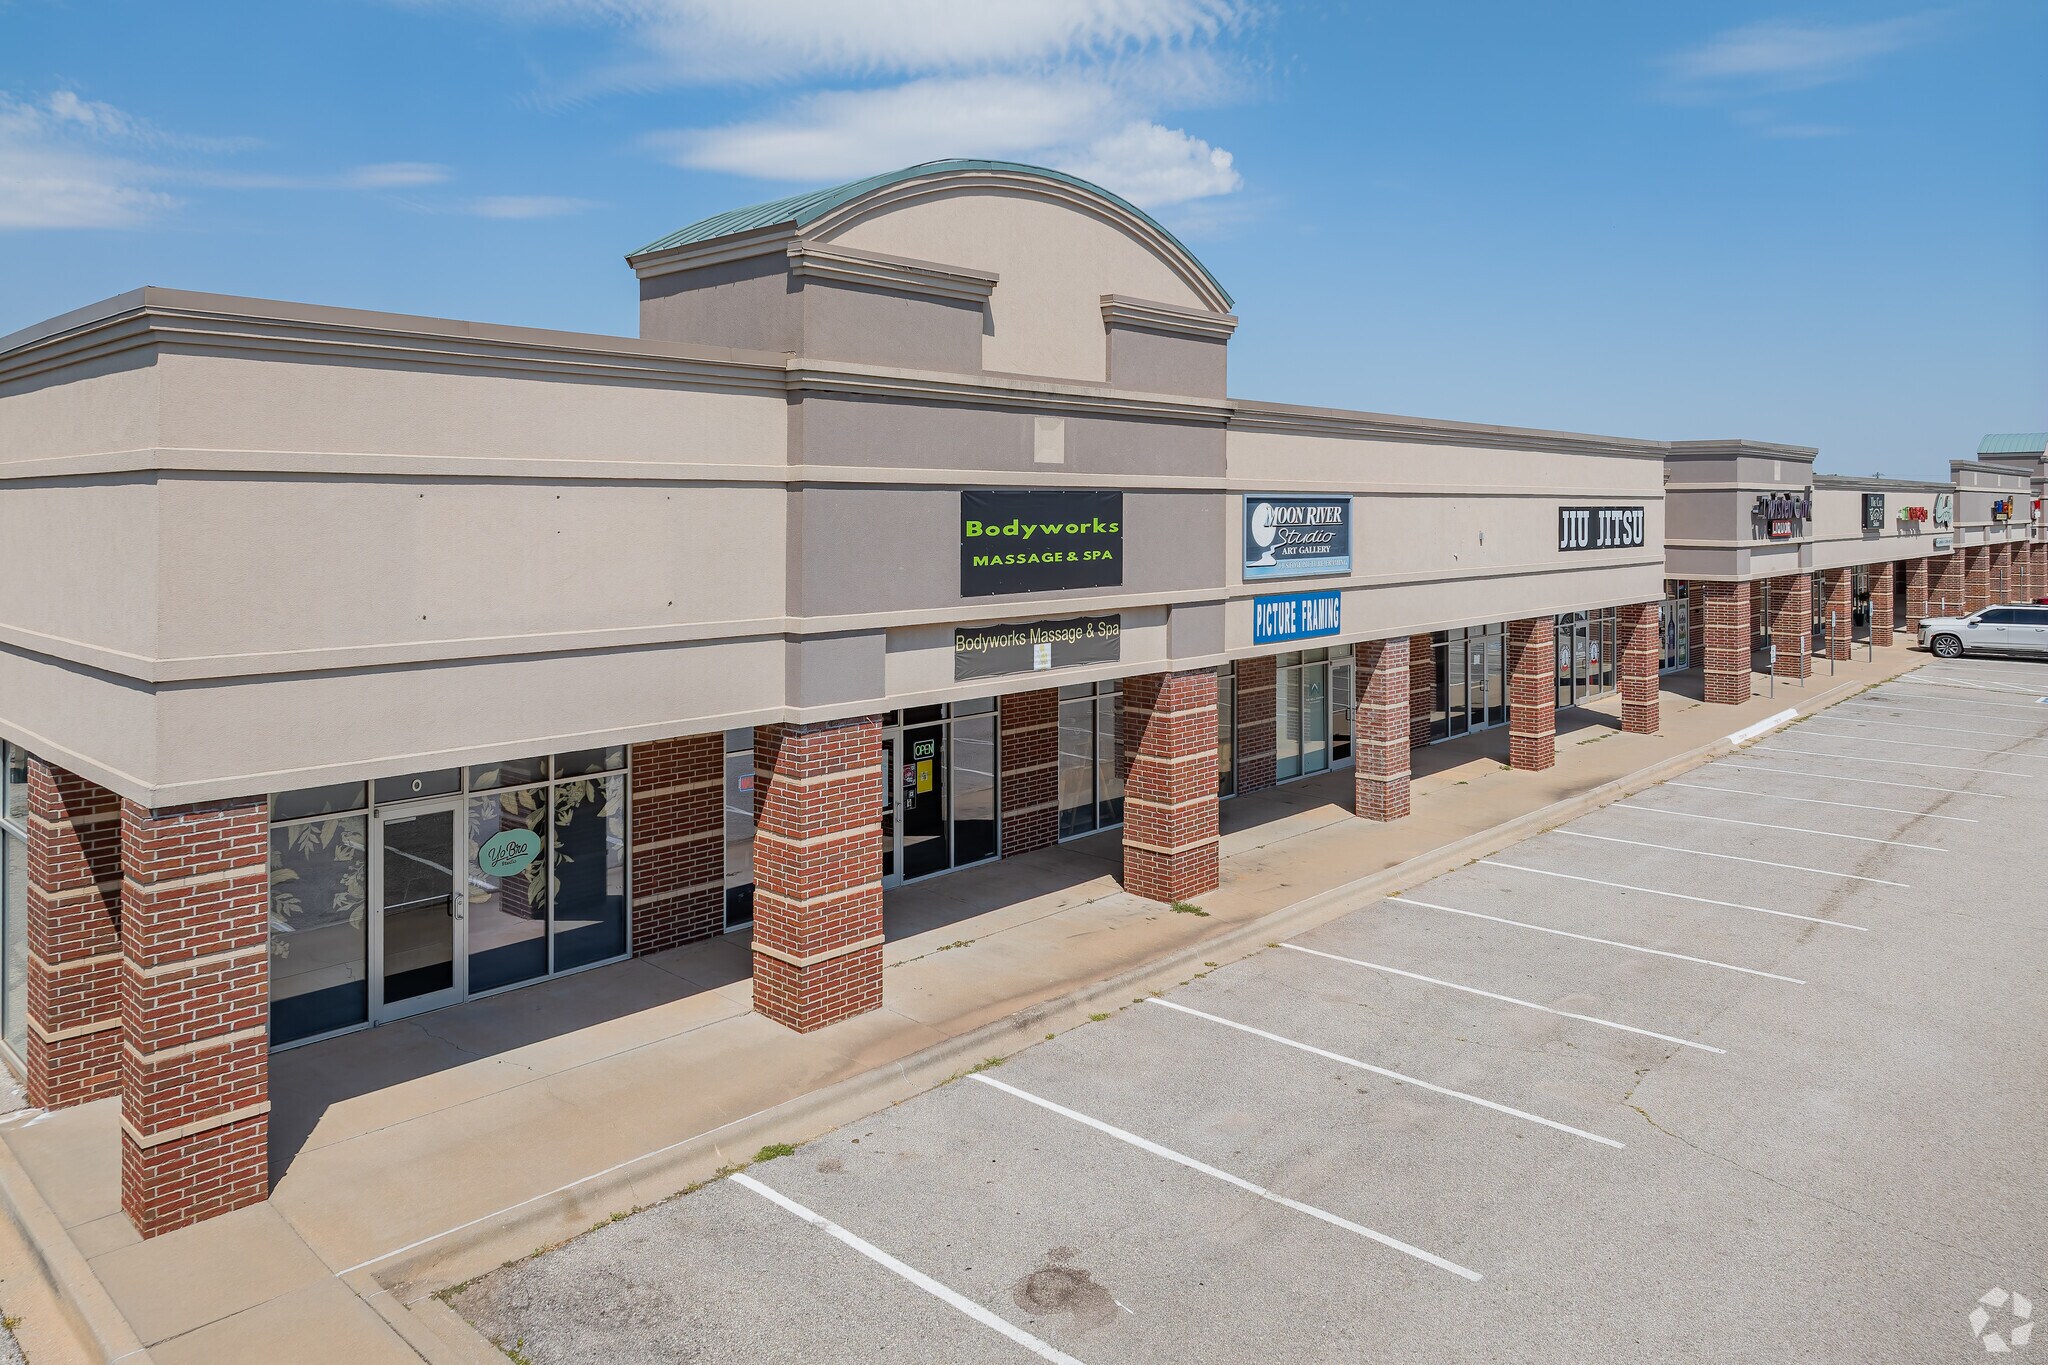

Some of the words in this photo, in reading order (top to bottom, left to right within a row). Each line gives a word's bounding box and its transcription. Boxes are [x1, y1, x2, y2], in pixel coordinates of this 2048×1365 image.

[1264, 506, 1306, 527] MOON
[1306, 506, 1343, 525] RIVER
[965, 517, 1119, 540] Bodyworks
[1277, 527, 1337, 545] Studio
[1560, 510, 1590, 549] JIU
[1596, 510, 1644, 547] JITSU
[973, 552, 1063, 567] MASSAGE
[1066, 551, 1079, 562] &
[1083, 549, 1113, 561] SPA
[1298, 545, 1331, 554] GALLERY
[1256, 601, 1297, 637] PICTURE
[1301, 597, 1339, 632] FRAMING
[956, 630, 1027, 654] Bodyworks
[1029, 627, 1083, 644] Massage
[1086, 622, 1095, 638] &
[1097, 621, 1119, 640] Spa
[915, 743, 934, 757] OPEN
